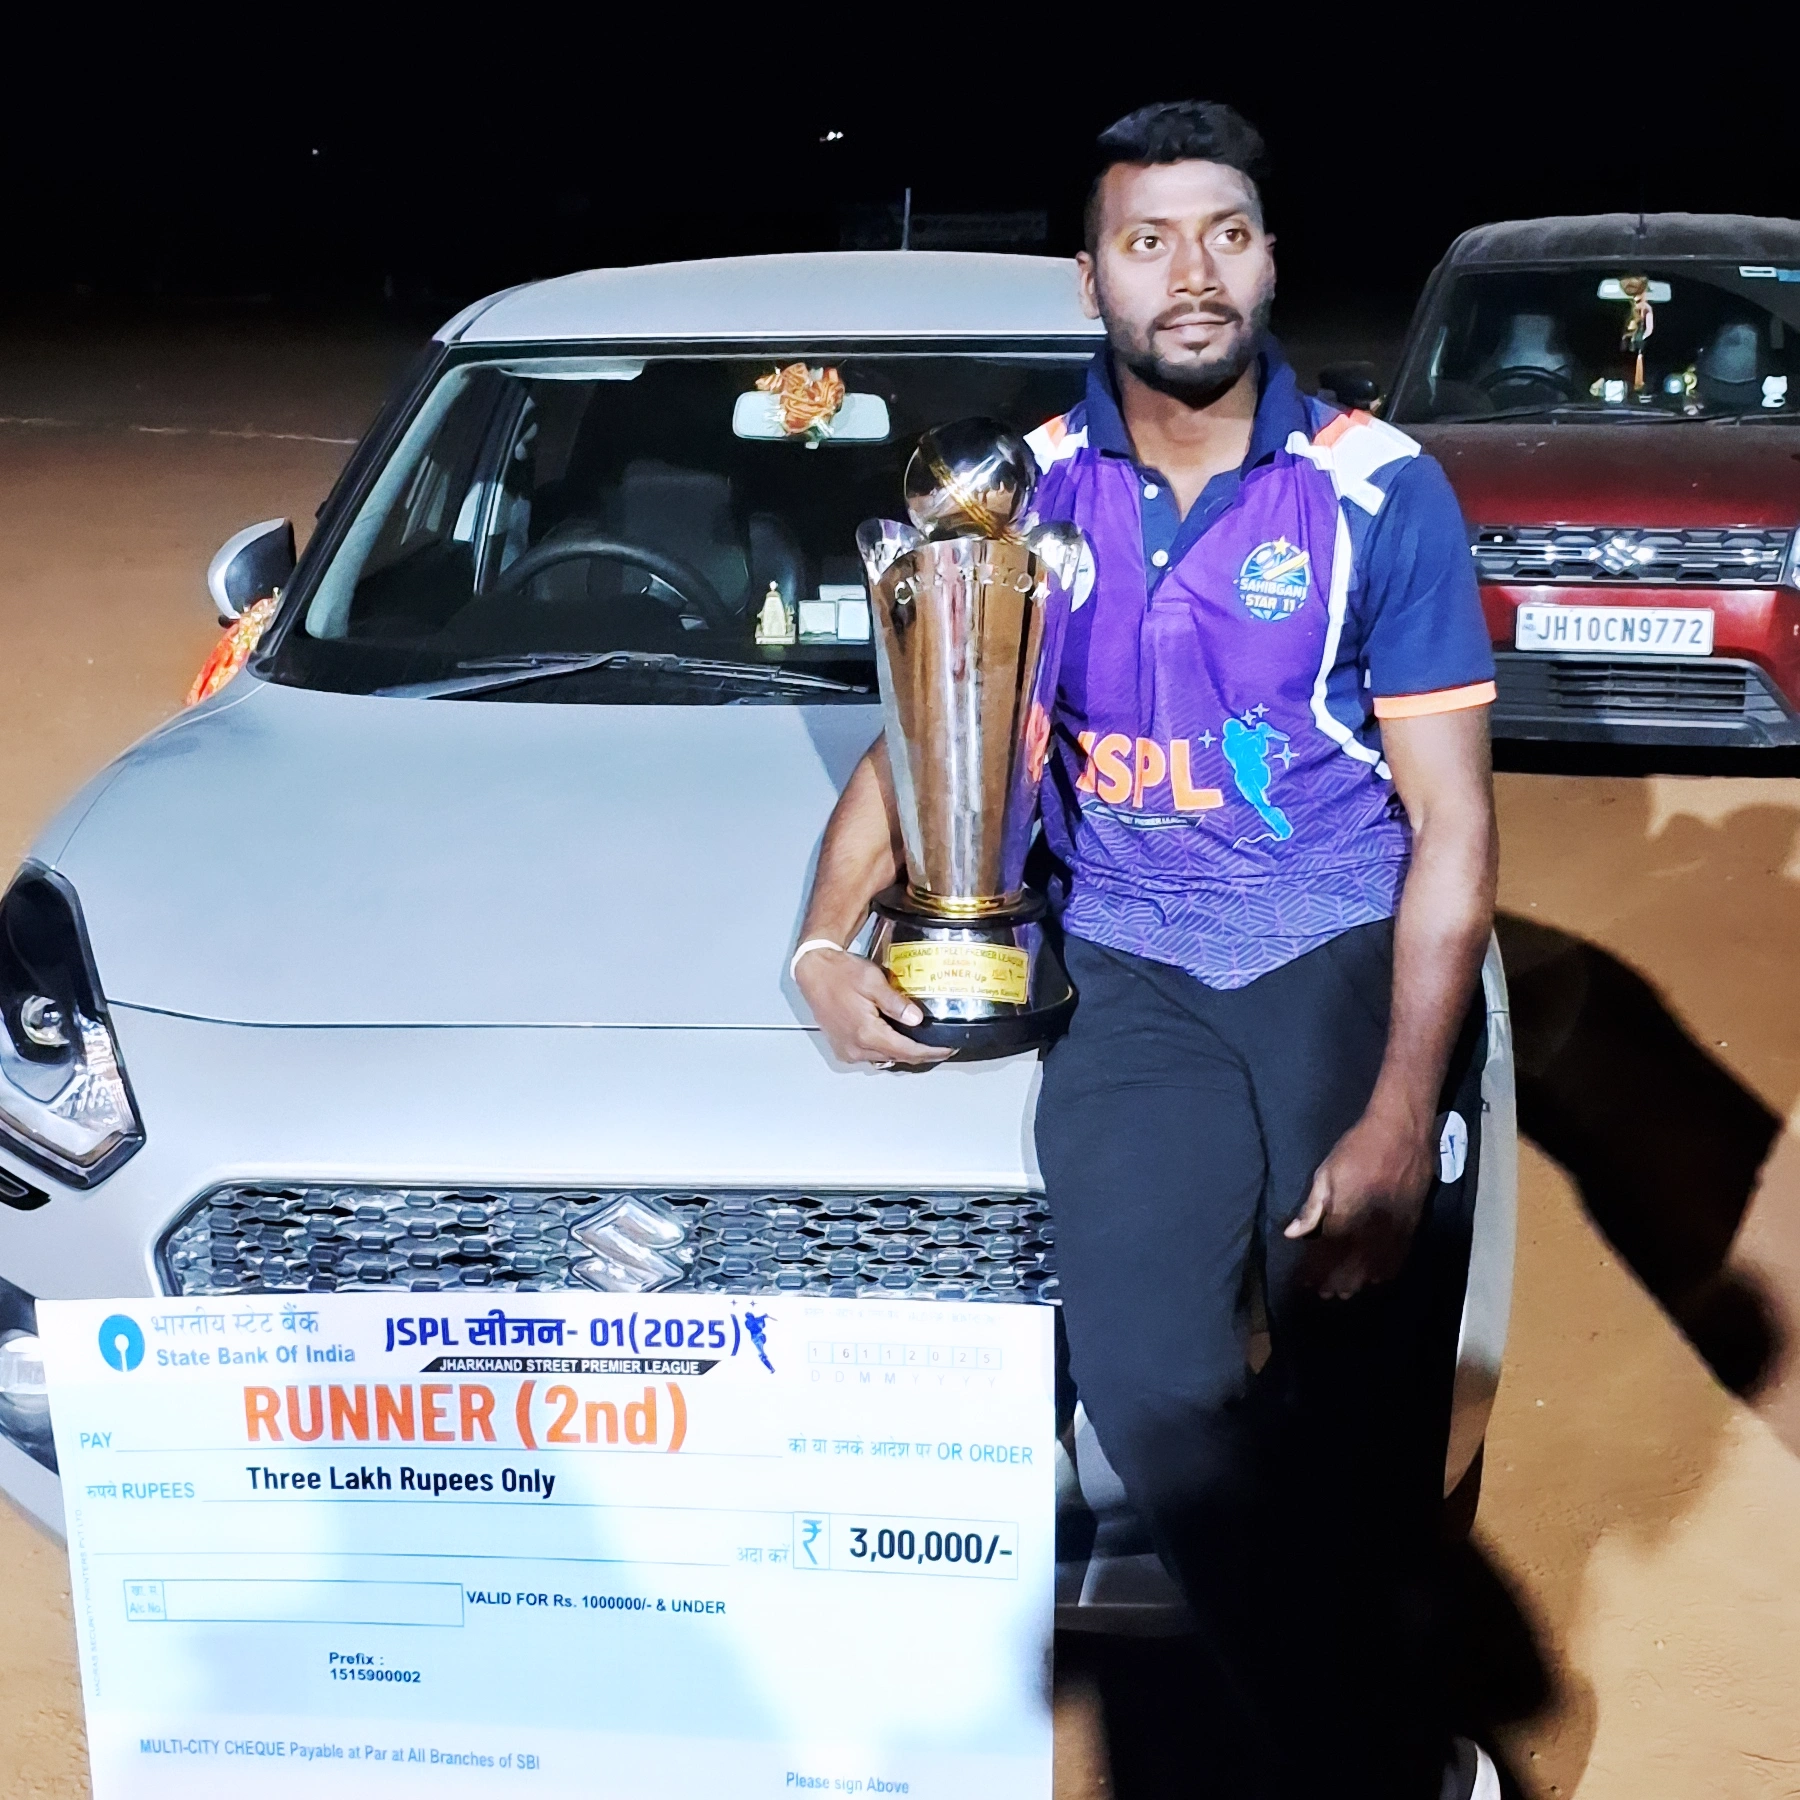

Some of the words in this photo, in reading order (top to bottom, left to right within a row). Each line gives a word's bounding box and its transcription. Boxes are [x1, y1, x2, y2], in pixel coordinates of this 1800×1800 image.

[1245, 593, 1278, 610] STAR
[1537, 615, 1704, 645] JH10CN9772
[1074, 730, 1225, 812] JSPL
[151, 1306, 226, 1336] भारतीय
[233, 1306, 273, 1334] स्टेट
[280, 1303, 320, 1333] बैंक
[384, 1317, 459, 1353] JSPL
[157, 1348, 210, 1367] State
[217, 1346, 269, 1365] Bank
[276, 1344, 298, 1363] Of
[306, 1344, 356, 1363] India
[439, 1357, 523, 1372] JHARKHAND
[526, 1358, 578, 1373] STREET
[581, 1359, 642, 1373] PREMIER
[644, 1360, 699, 1375] LEAGUE
[243, 1383, 498, 1443] RUNNER
[515, 1380, 688, 1453] (2nd)
[80, 1431, 112, 1449] PAY
[788, 1433, 807, 1454] को
[832, 1435, 864, 1456] उनके
[870, 1436, 910, 1459] आदेश
[915, 1442, 932, 1458] पर
[937, 1441, 963, 1461] OR
[969, 1443, 1033, 1465] ORDER
[85, 1480, 117, 1499] रुपये
[122, 1482, 195, 1499] RUPEES
[246, 1466, 322, 1491] Three
[329, 1467, 392, 1491] Lakh
[400, 1467, 494, 1497] Rupees
[502, 1468, 557, 1499] Only
[849, 1527, 1013, 1565] 3,00,000/-
[466, 1590, 512, 1605] VALID
[516, 1592, 549, 1607] FOR
[553, 1594, 577, 1608] Rs.
[581, 1594, 652, 1611] 1000000/-
[655, 1597, 667, 1612] &
[671, 1599, 727, 1615] UNDER
[329, 1652, 374, 1666] Prefix
[329, 1668, 422, 1684] 1515900002
[140, 1738, 220, 1755] MULTI-CITY
[224, 1741, 286, 1758] CHEQUE
[289, 1742, 344, 1761] Payable
[348, 1746, 361, 1760] at
[364, 1746, 386, 1761] Par
[391, 1747, 404, 1762] at
[408, 1747, 426, 1763] All
[430, 1750, 494, 1768] Branches
[499, 1753, 512, 1769] of
[516, 1755, 540, 1770] SBI
[786, 1772, 830, 1790] Please
[834, 1775, 863, 1795] sign
[866, 1776, 909, 1794] Above
